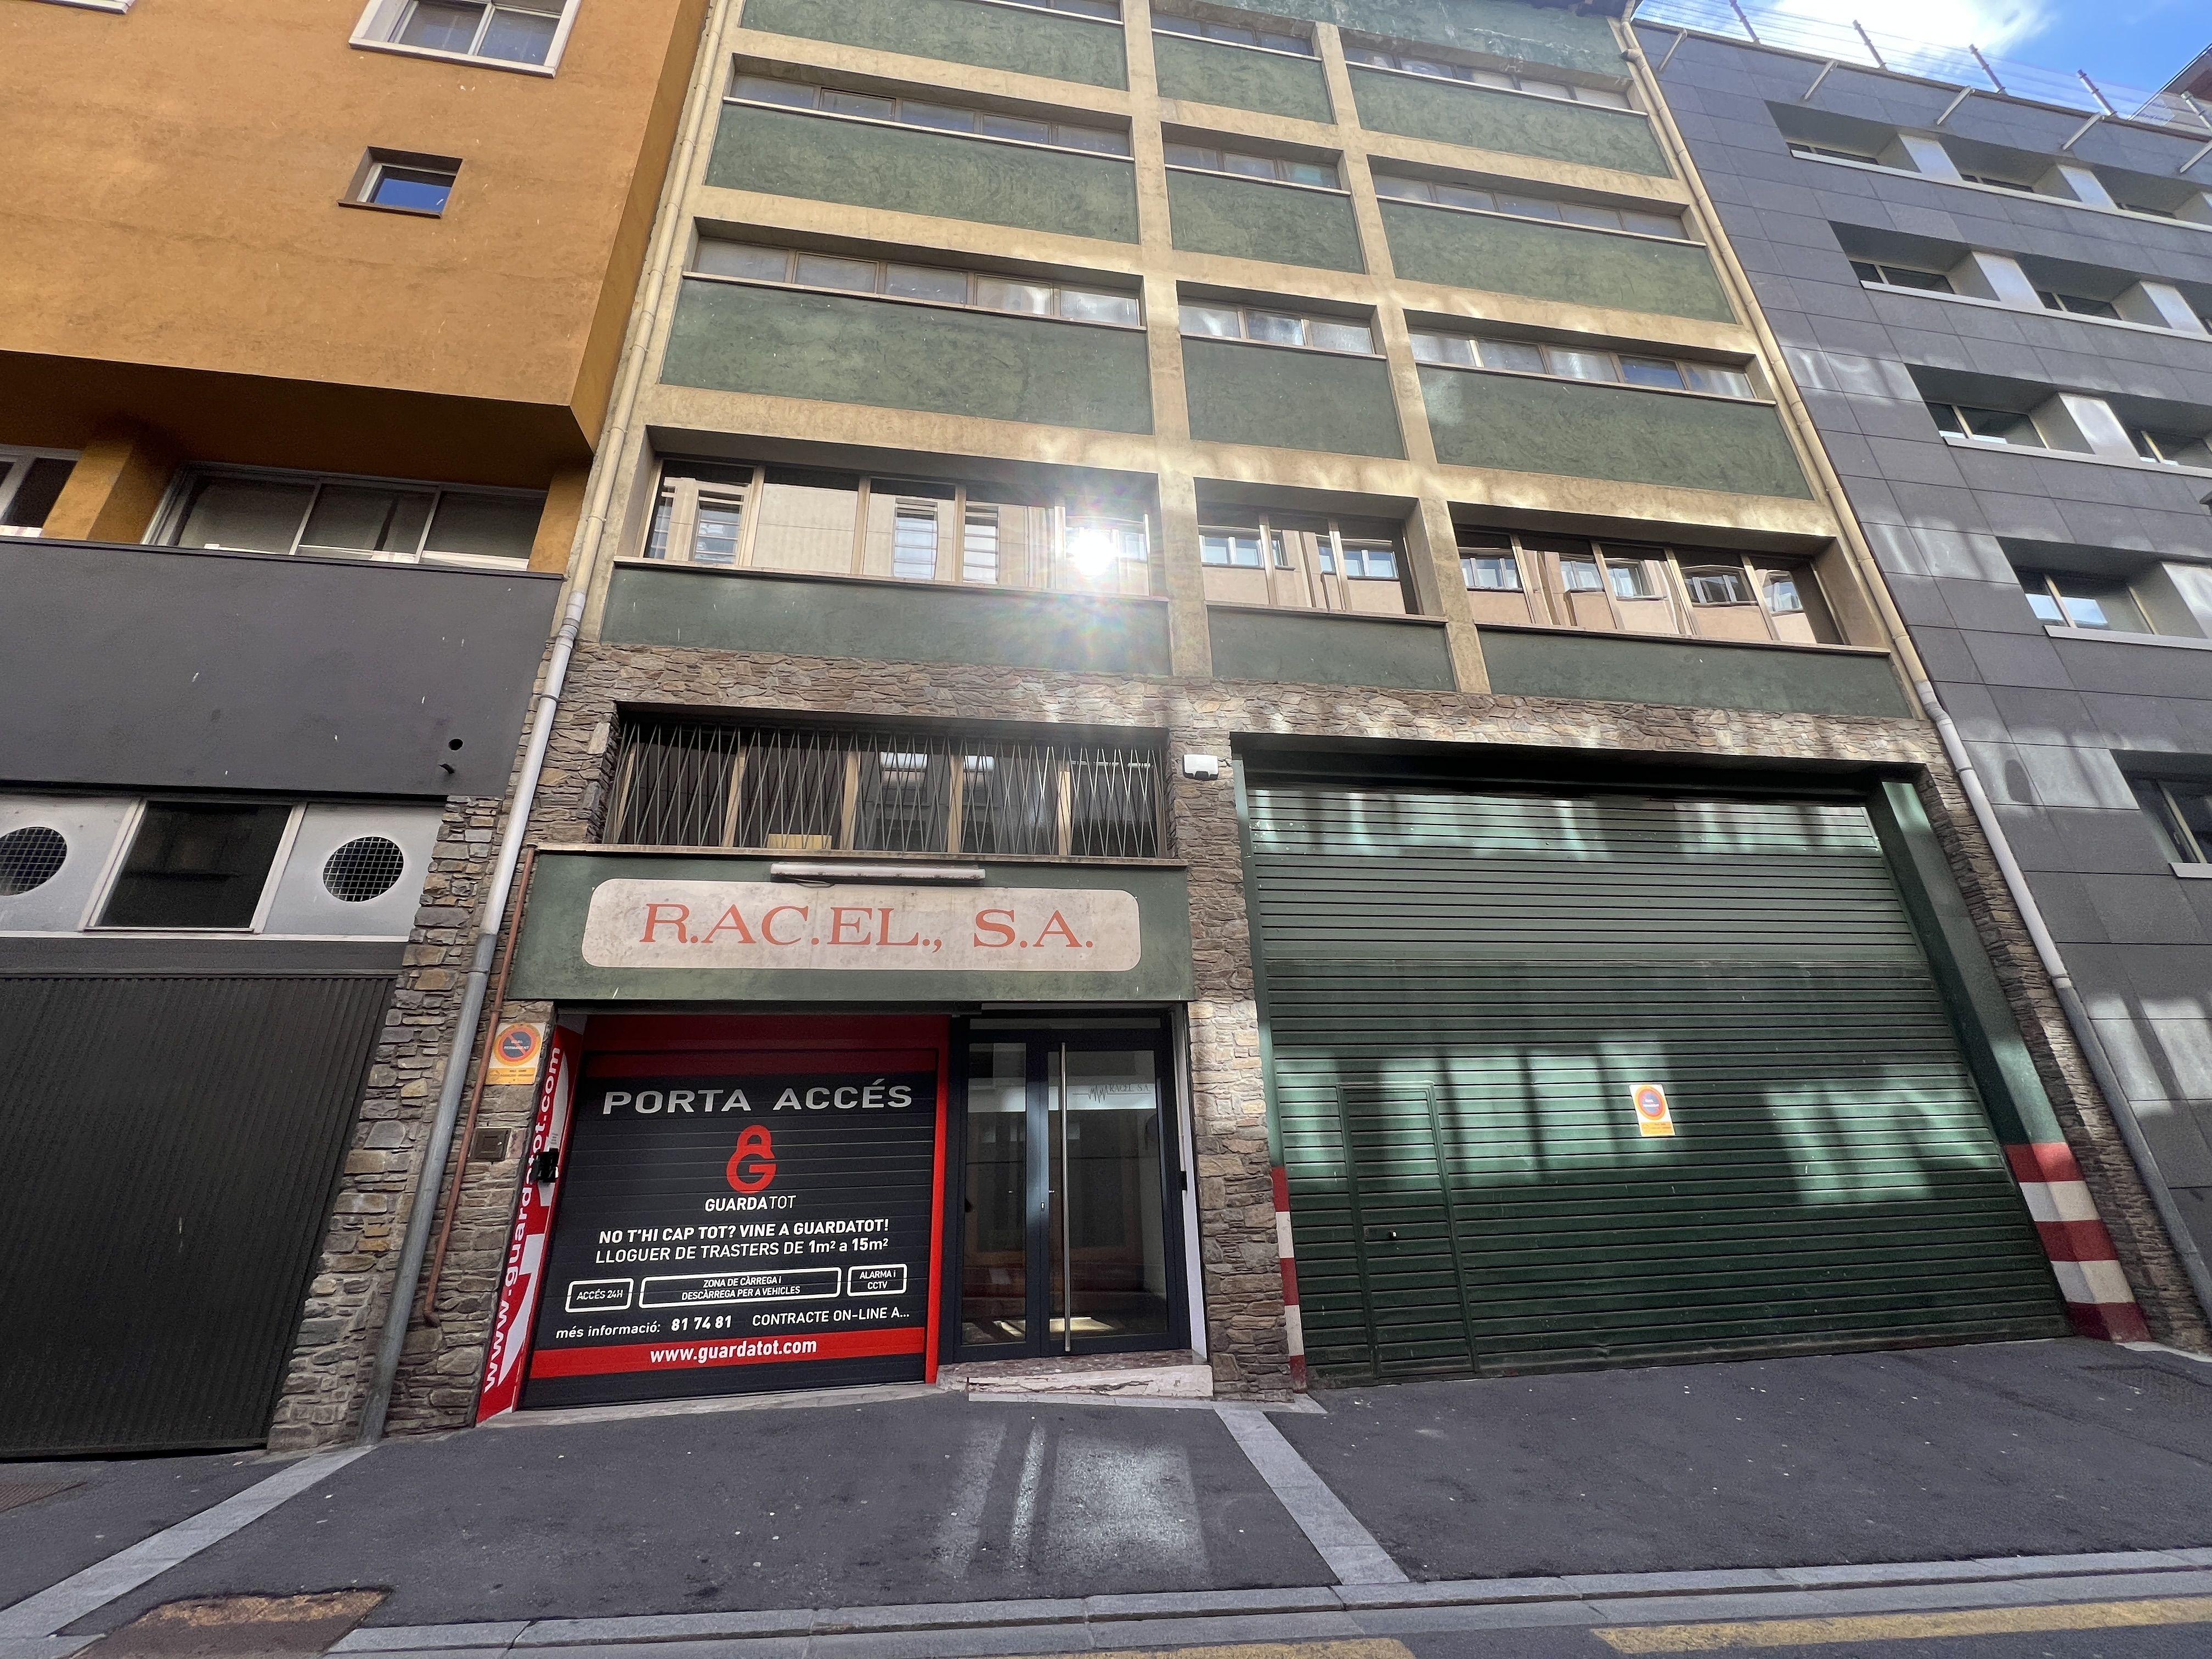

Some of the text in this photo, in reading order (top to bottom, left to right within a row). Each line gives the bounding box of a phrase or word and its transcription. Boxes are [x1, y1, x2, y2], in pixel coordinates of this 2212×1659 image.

[974, 909, 1094, 948] S.A.
[602, 1078, 912, 1115] PORTA ACCÉS
[705, 1195, 797, 1212] GUARDATOT
[484, 1047, 560, 1393] www.guardot.com
[599, 1218, 889, 1244] NO T'HI CAP TOT? VINE A GUARDATOT!
[595, 1247, 671, 1263] LLOGUER
[675, 1246, 697, 1260] DE
[700, 1242, 779, 1259] TRASTERS
[783, 1241, 804, 1255] DE
[839, 1242, 848, 1252] a
[703, 1279, 726, 1288] ZONA
[727, 1278, 739, 1286] DE
[740, 1276, 777, 1285] CÀRREGA
[859, 1270, 891, 1279] ALARMA
[867, 1280, 888, 1290] CCTV
[576, 1288, 623, 1300] ACCÉS 24H
[681, 1290, 735, 1300] DESCÀRREGA
[737, 1289, 753, 1297] PER
[761, 1286, 800, 1295] VEHICLES
[556, 1315, 731, 1339] més informació: 81 74 81
[752, 1306, 910, 1327] CONTRACTE ON-LINE A...
[650, 1340, 817, 1364] www.guardatot.com
